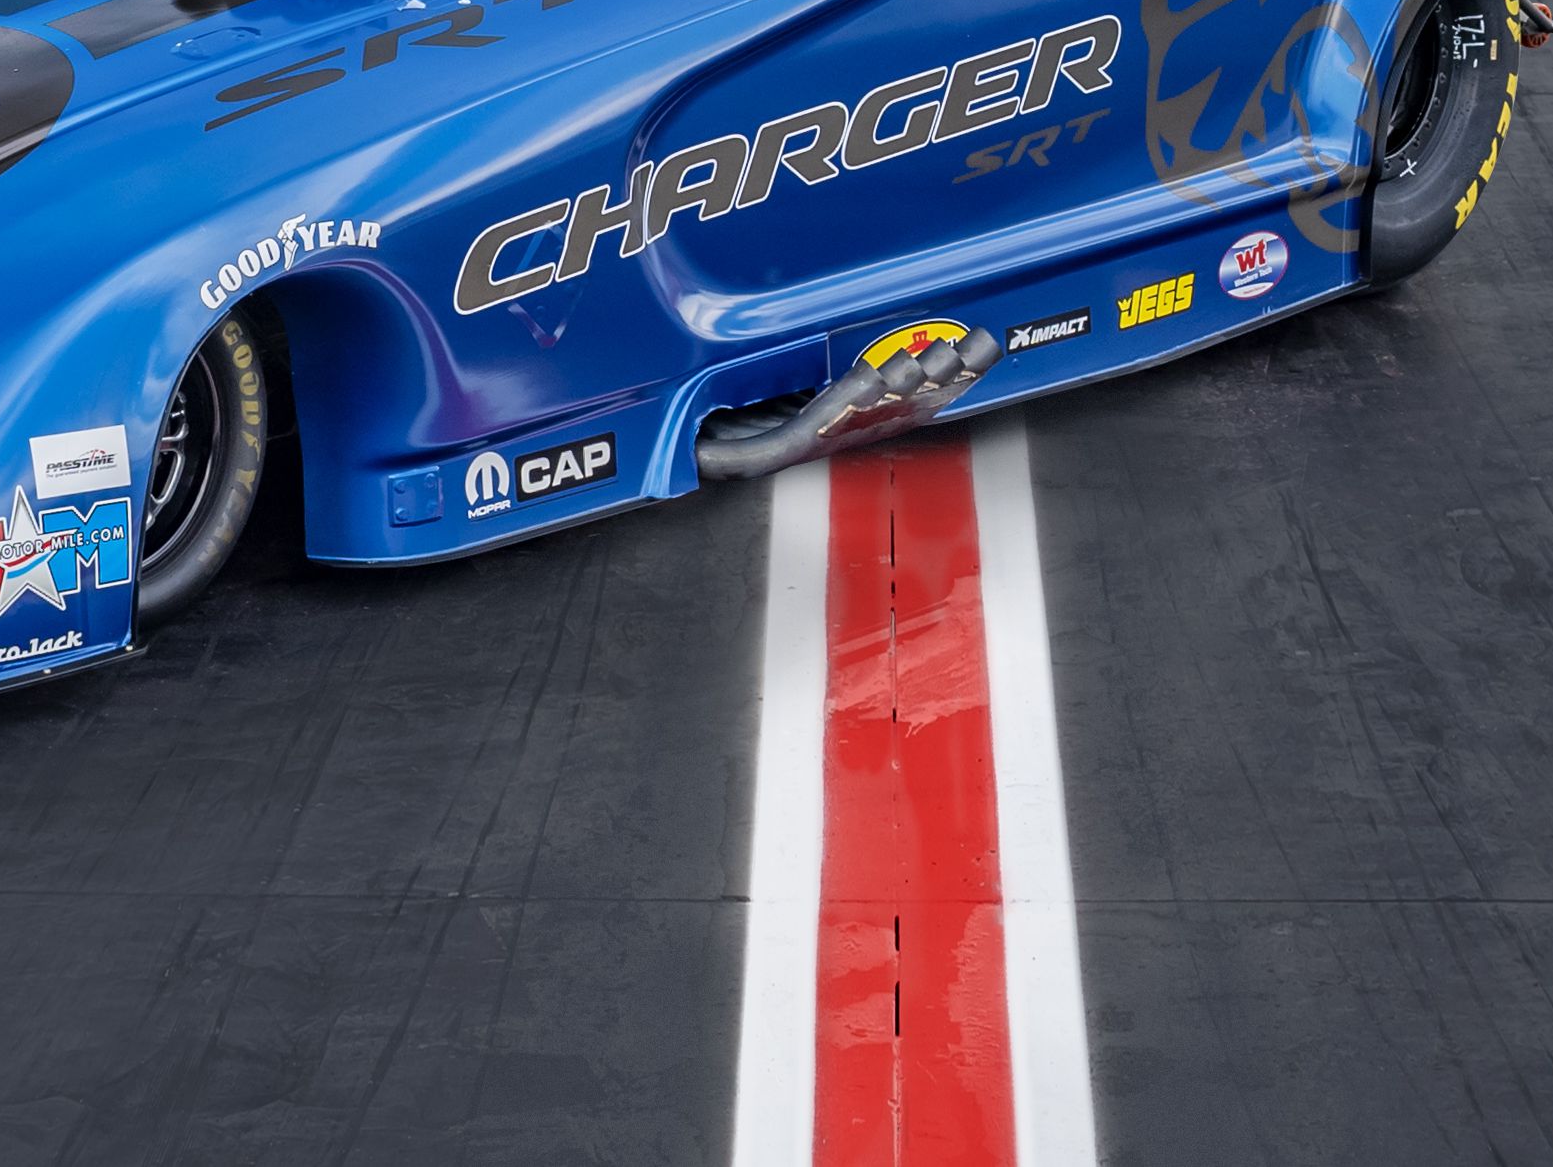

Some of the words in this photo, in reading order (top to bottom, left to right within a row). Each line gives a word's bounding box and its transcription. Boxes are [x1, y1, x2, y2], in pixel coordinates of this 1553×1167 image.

[453, 14, 1122, 315] CHARGER
[952, 109, 1111, 184] SRT
[199, 214, 382, 311] GOODYEAR
[1234, 238, 1267, 275] wt
[1118, 272, 1196, 331] JEGS
[1030, 315, 1089, 345] IMPACT
[520, 440, 612, 494] CAP
[467, 497, 512, 520] MOPAR
[49, 524, 126, 552] MILE.COM
